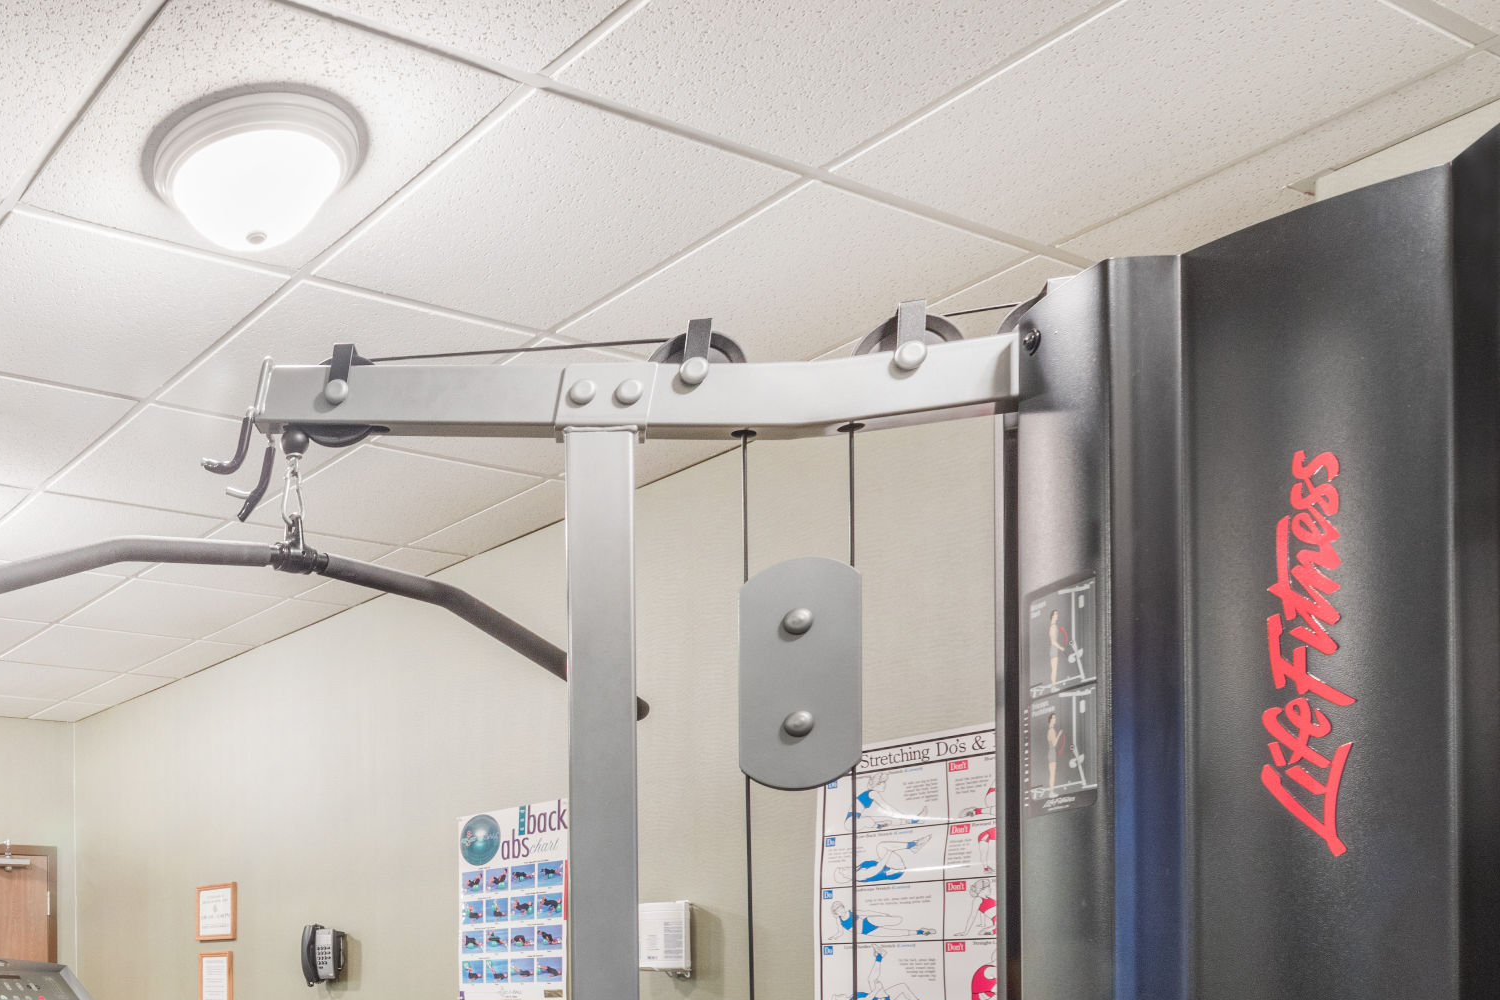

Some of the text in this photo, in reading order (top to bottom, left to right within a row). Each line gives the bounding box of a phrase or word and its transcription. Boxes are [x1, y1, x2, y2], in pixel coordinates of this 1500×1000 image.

[860, 735, 987, 769] Stretching Do's &
[950, 760, 967, 771] Don't
[527, 799, 568, 835] back
[951, 824, 969, 835] Don't
[501, 828, 530, 860] abs
[530, 838, 559, 854] chart
[947, 881, 965, 891] Don't
[946, 942, 965, 952] Don't
